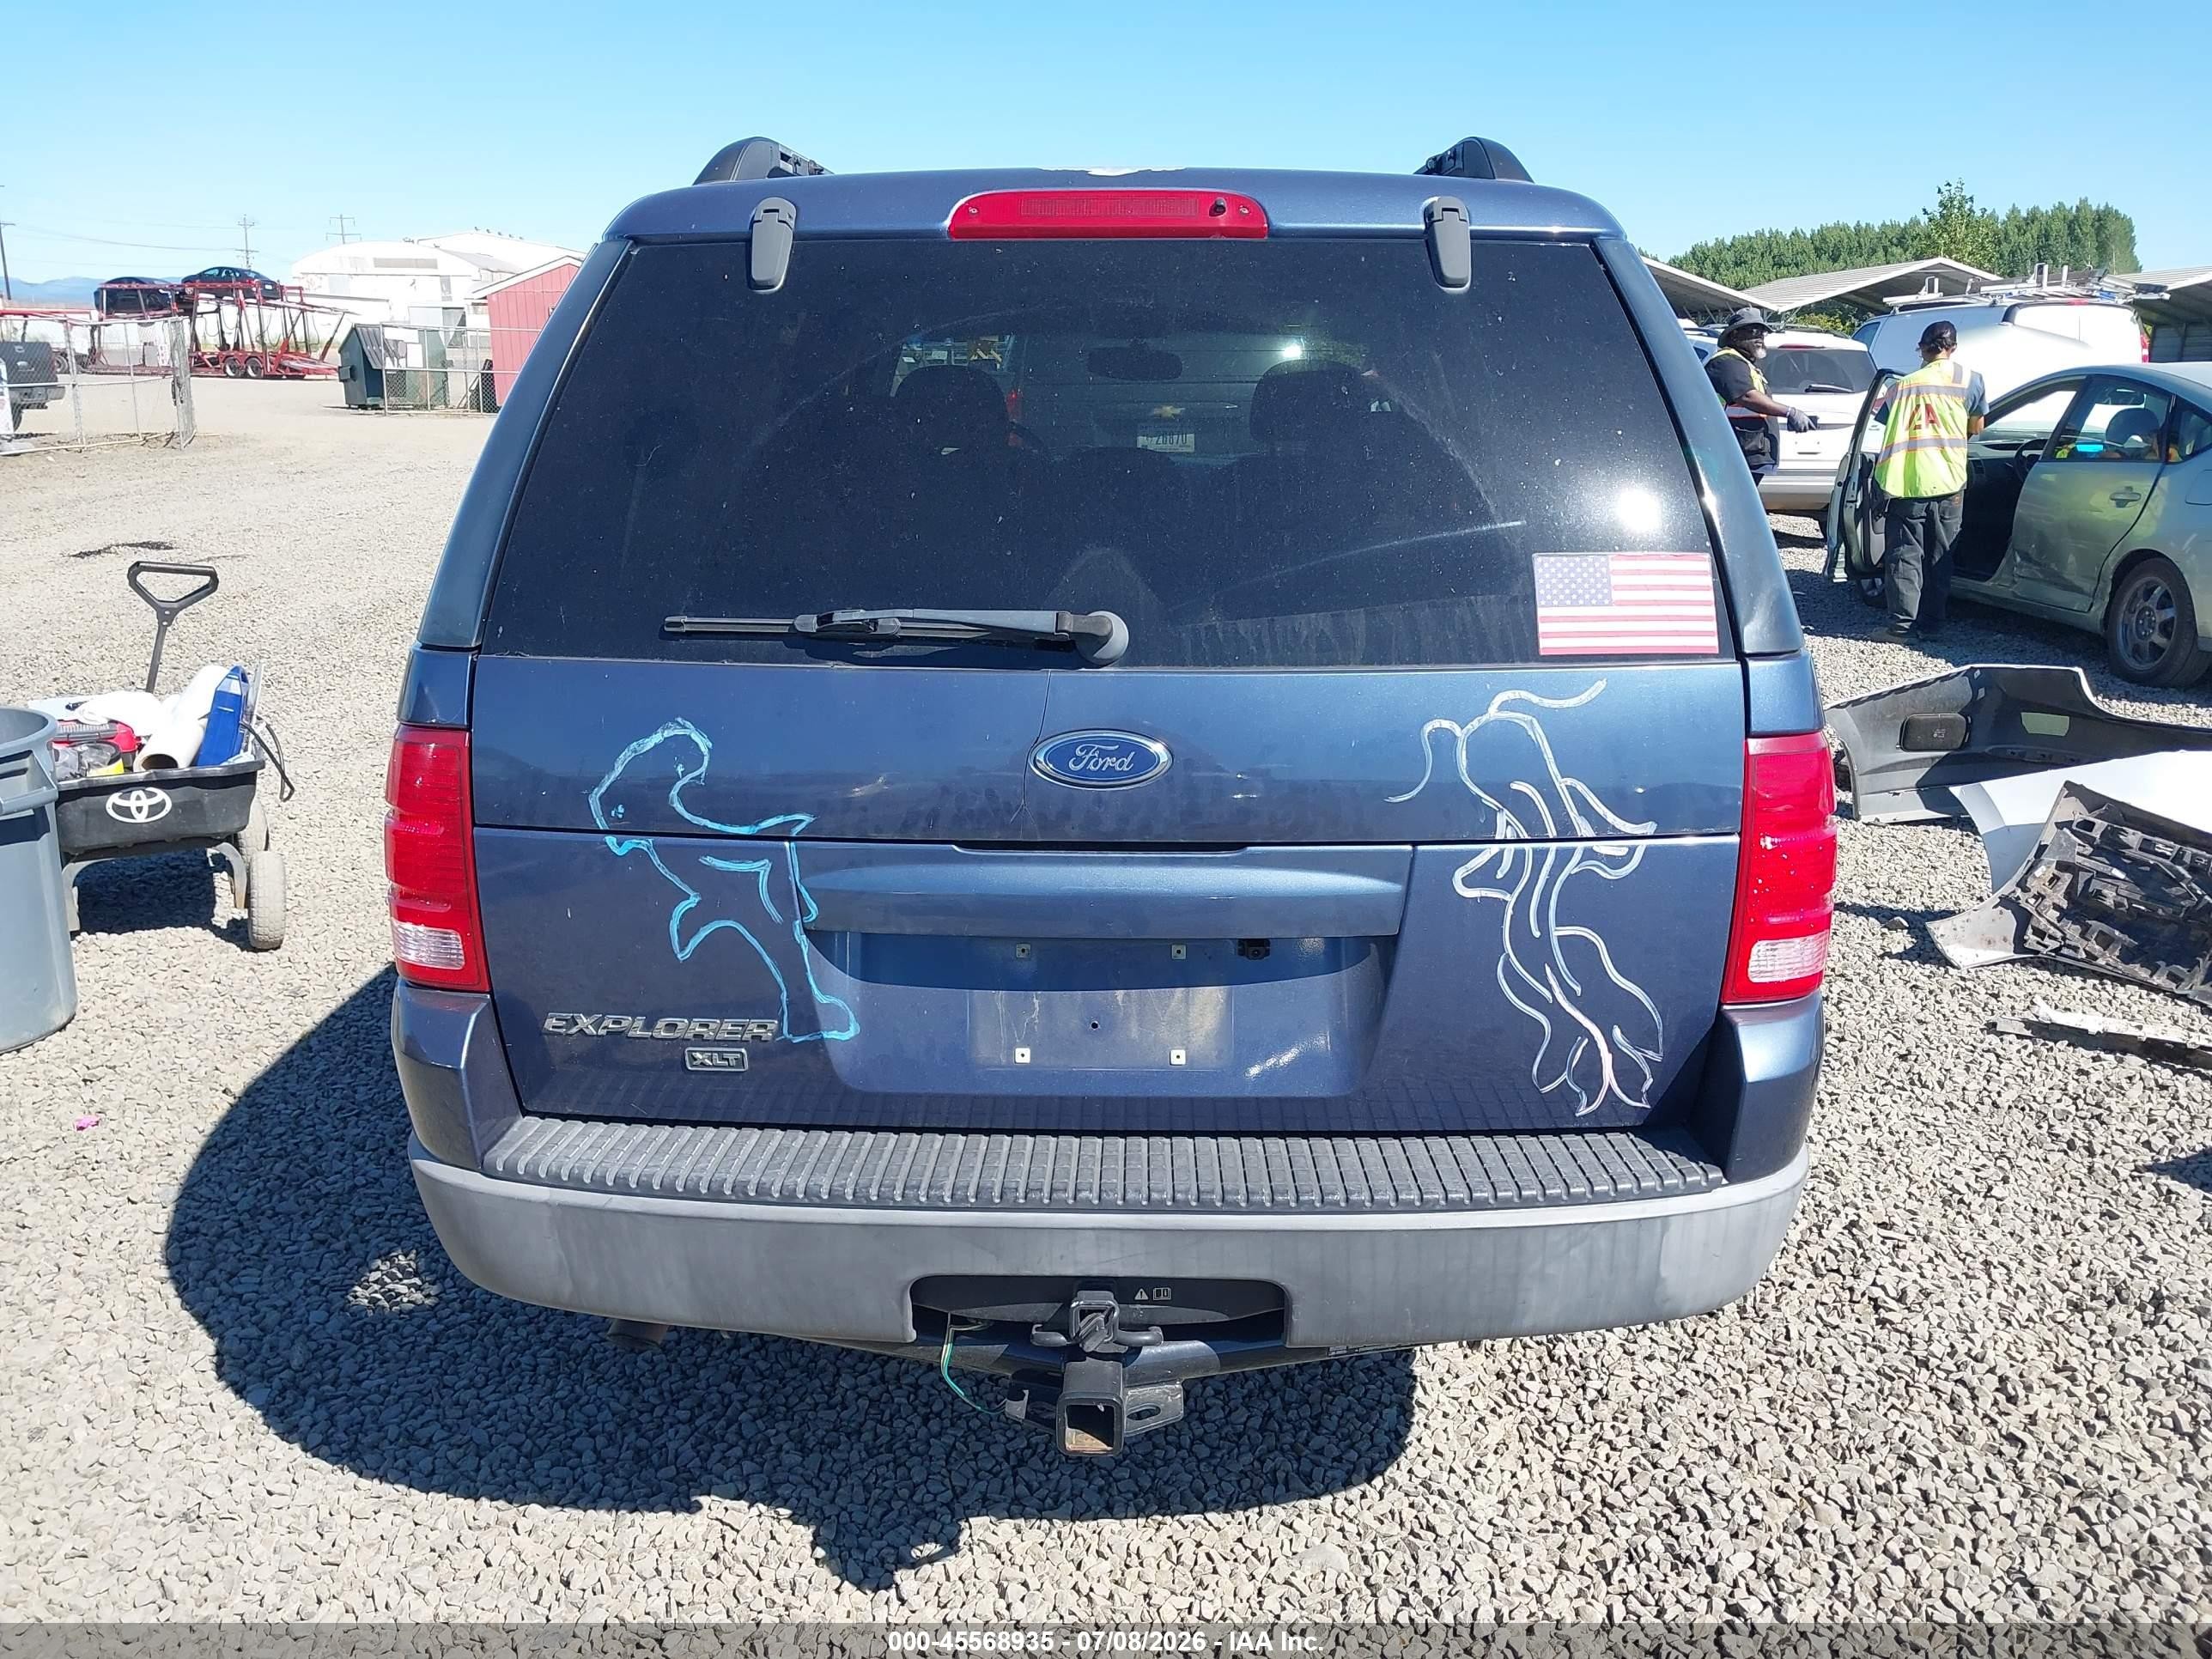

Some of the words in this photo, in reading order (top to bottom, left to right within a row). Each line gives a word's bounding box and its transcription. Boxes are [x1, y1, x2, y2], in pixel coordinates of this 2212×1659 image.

[1068, 744, 1136, 772] Ford
[541, 1012, 779, 1042] EXPLORER
[690, 1052, 741, 1067] XLT
